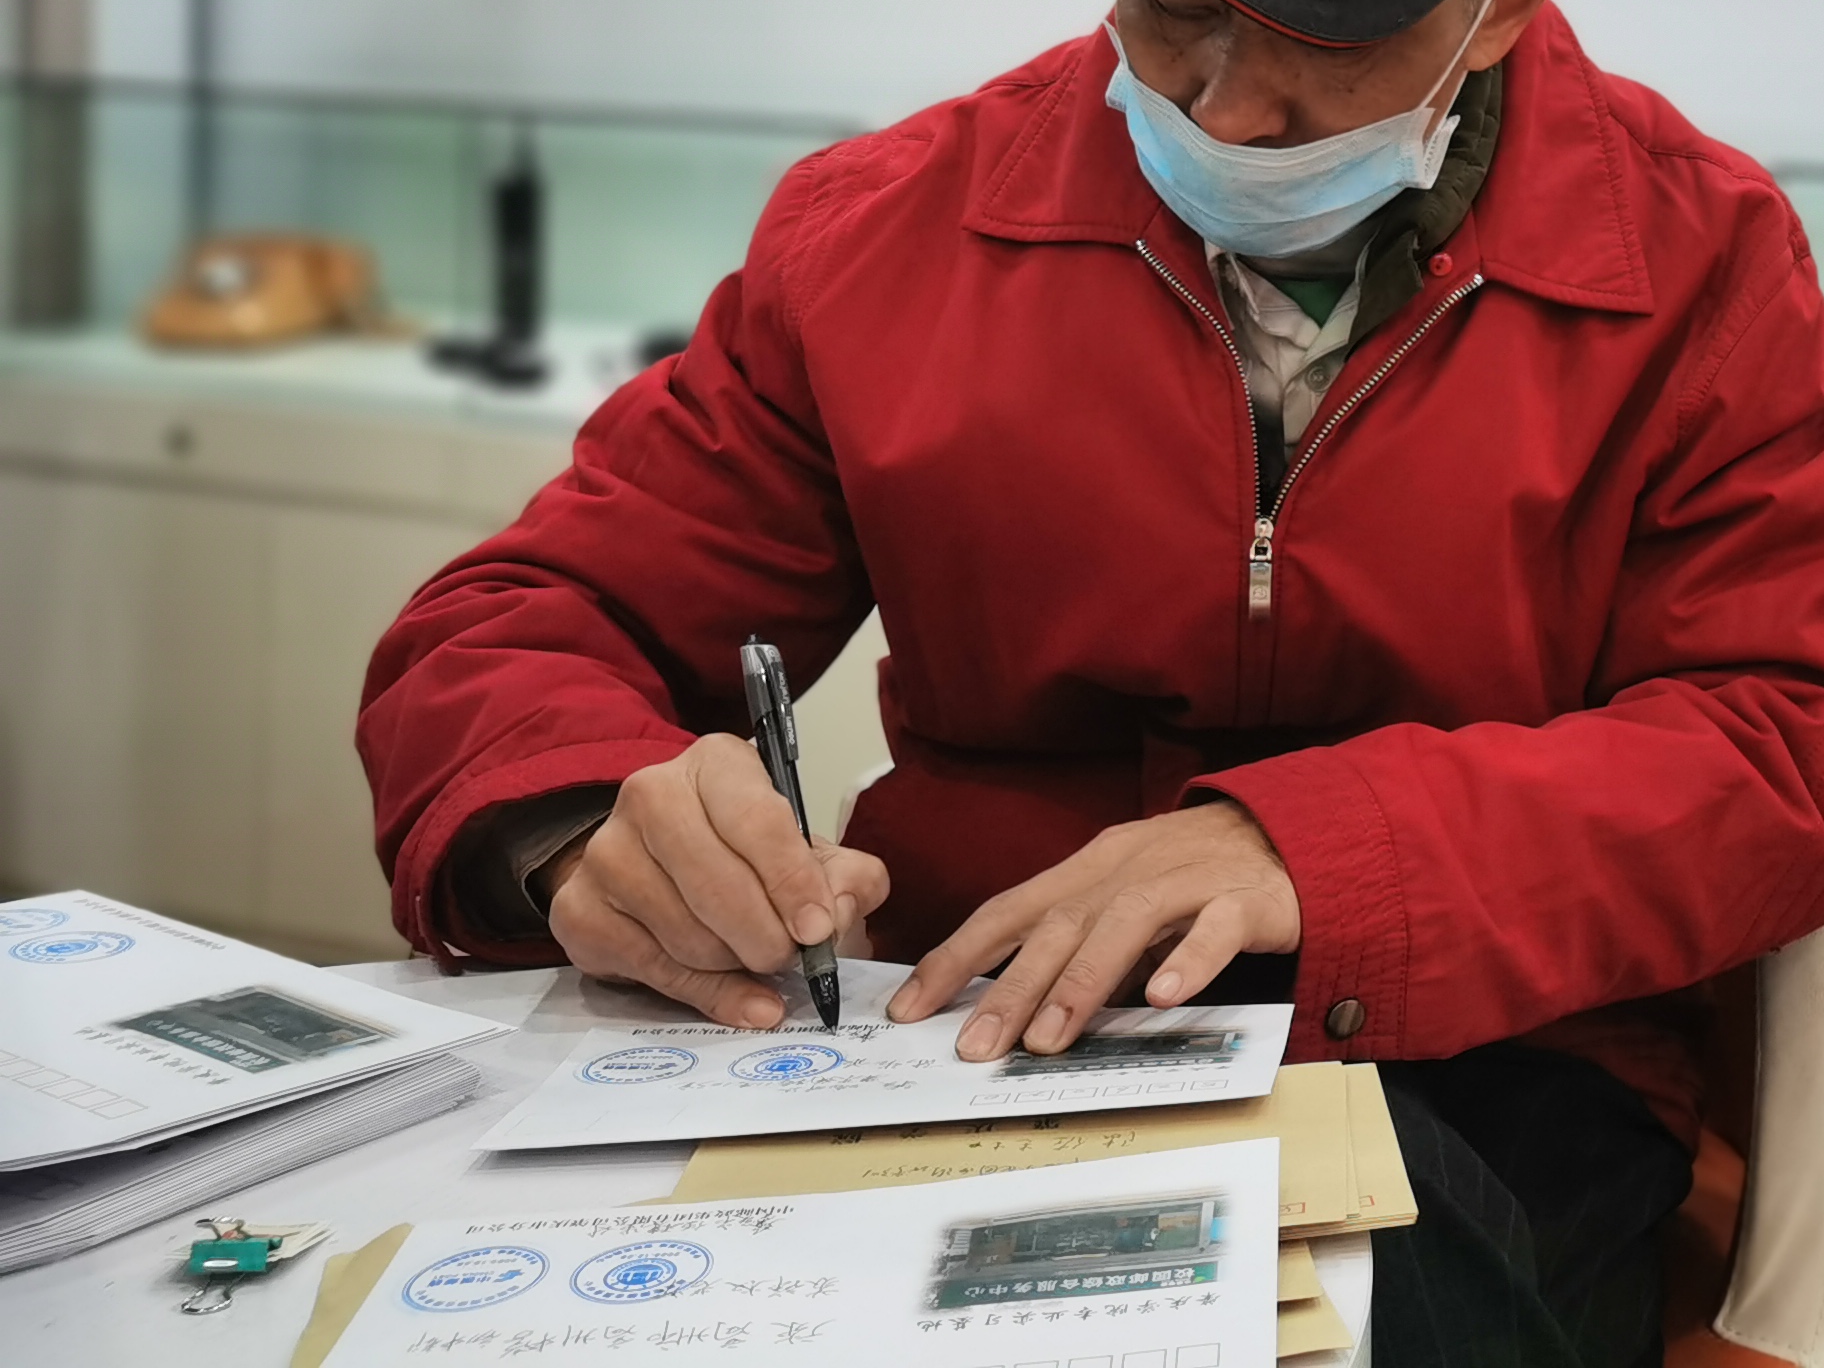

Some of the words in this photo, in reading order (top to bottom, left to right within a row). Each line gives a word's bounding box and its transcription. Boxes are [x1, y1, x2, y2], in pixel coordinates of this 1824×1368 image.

[963, 1267, 1196, 1299] 校园邮政综合服务中心
[914, 1291, 1222, 1333] 肇庆学院专业实习基地
